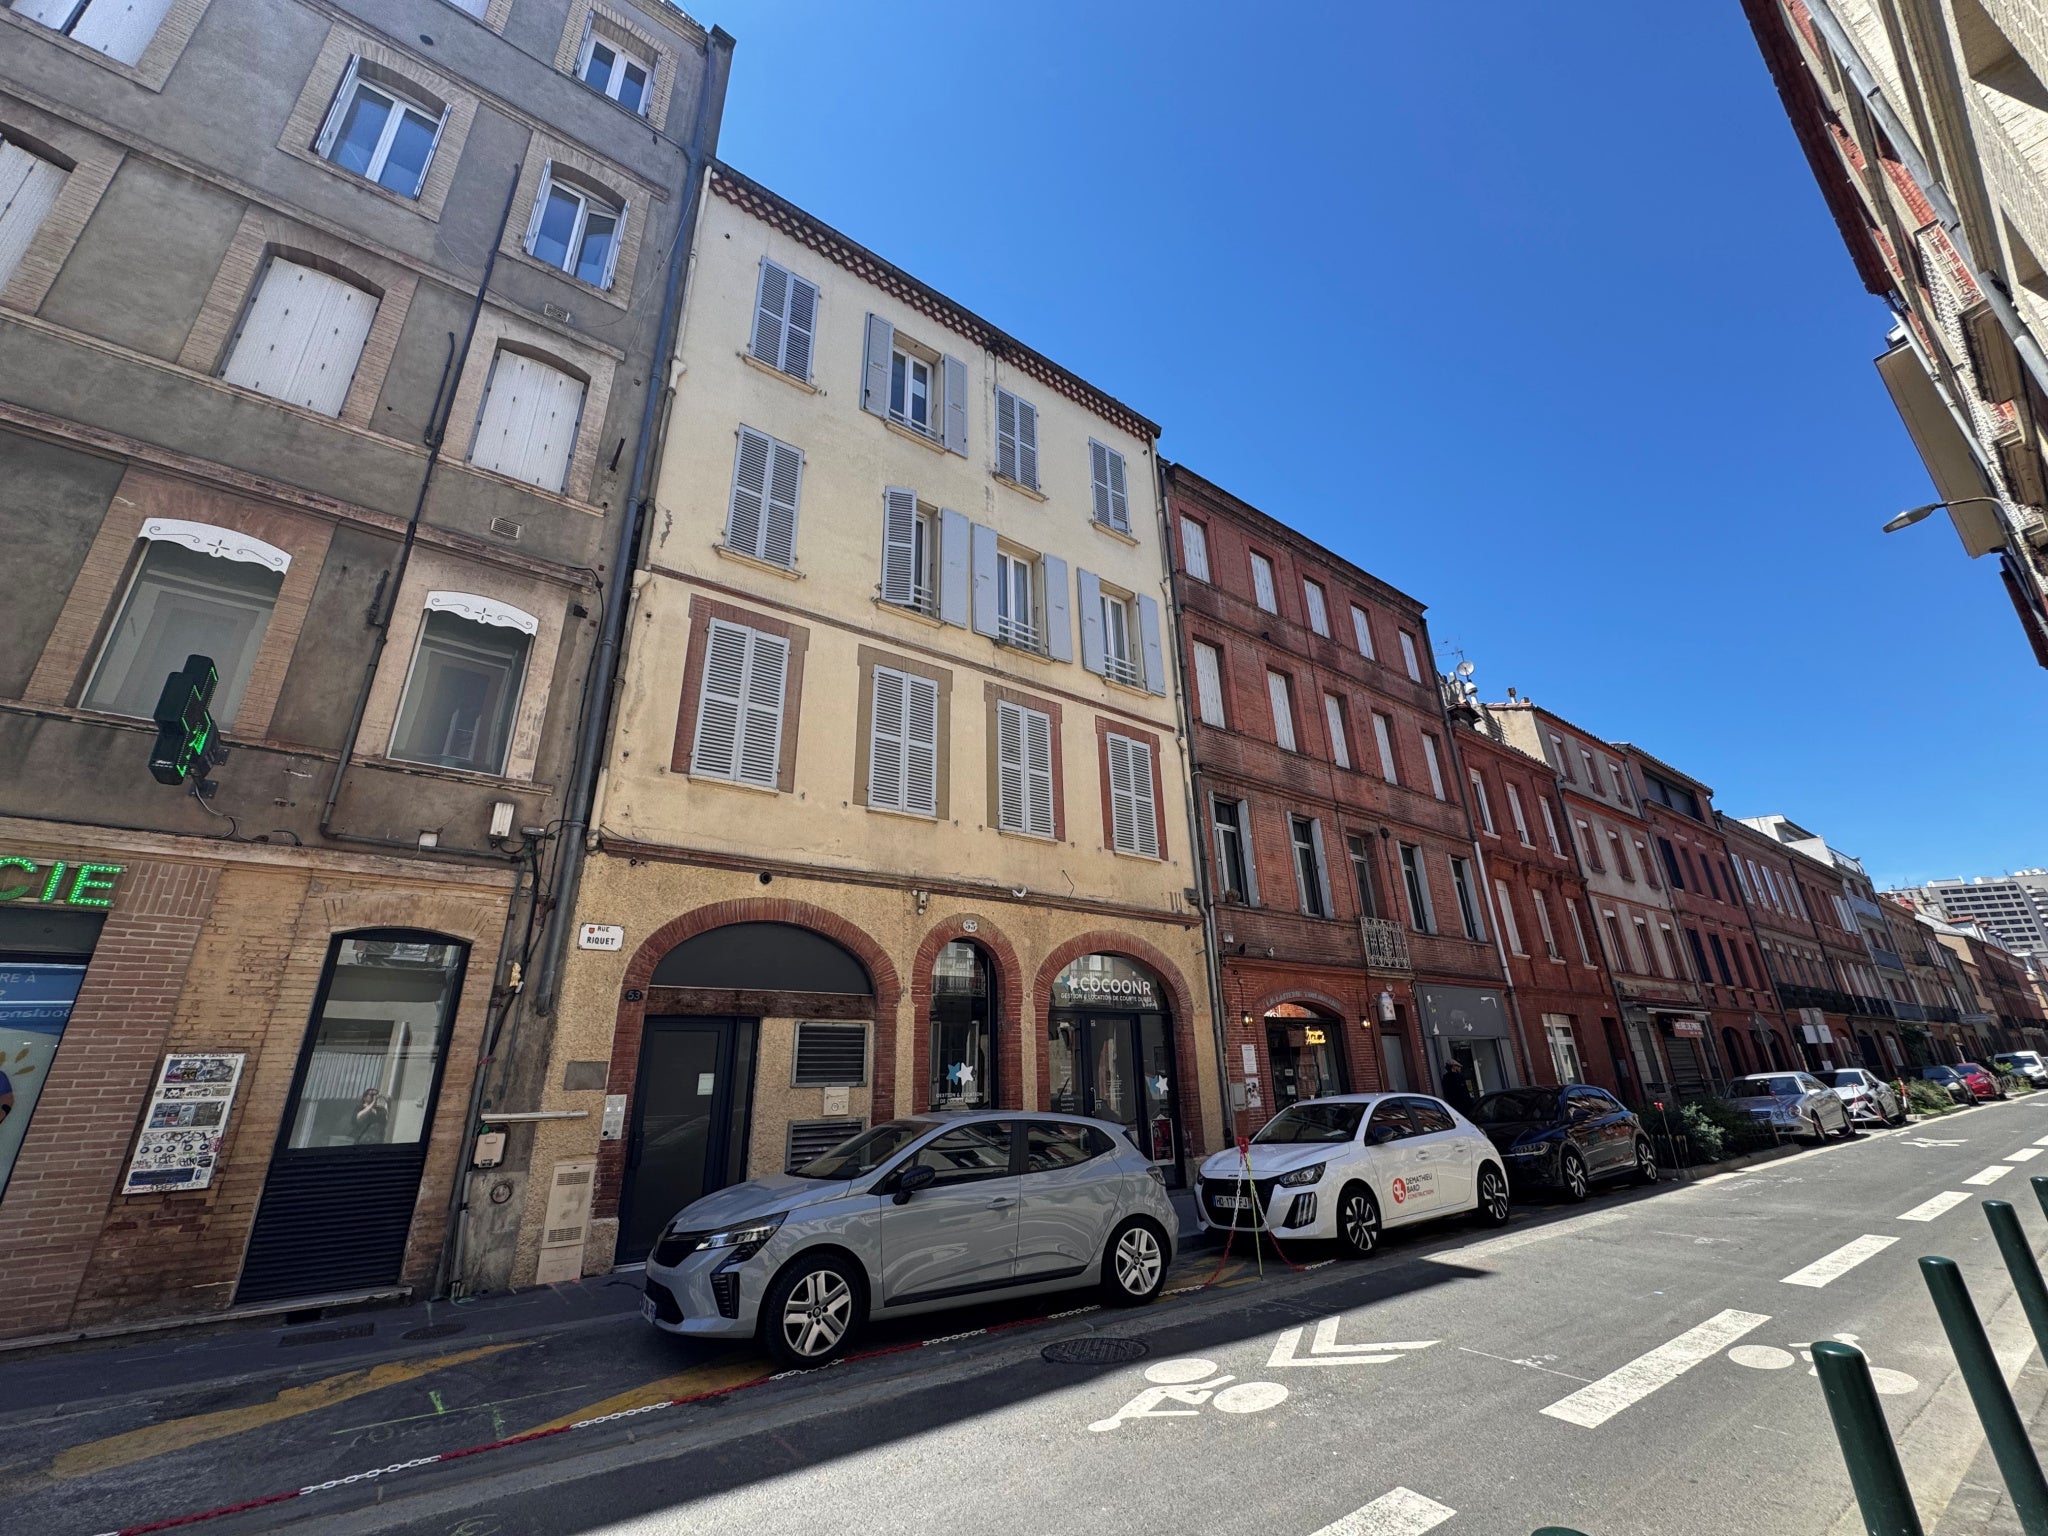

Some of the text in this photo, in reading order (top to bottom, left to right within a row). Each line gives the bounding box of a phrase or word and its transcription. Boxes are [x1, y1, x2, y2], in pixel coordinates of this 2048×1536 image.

[0, 857, 122, 906] CIE
[586, 936, 616, 945] RIQUET
[1080, 976, 1152, 996] COCOONR
[627, 990, 641, 1000] 53
[1060, 992, 1083, 1000] GESTION
[1405, 1173, 1433, 1185] DEMATHIEU
